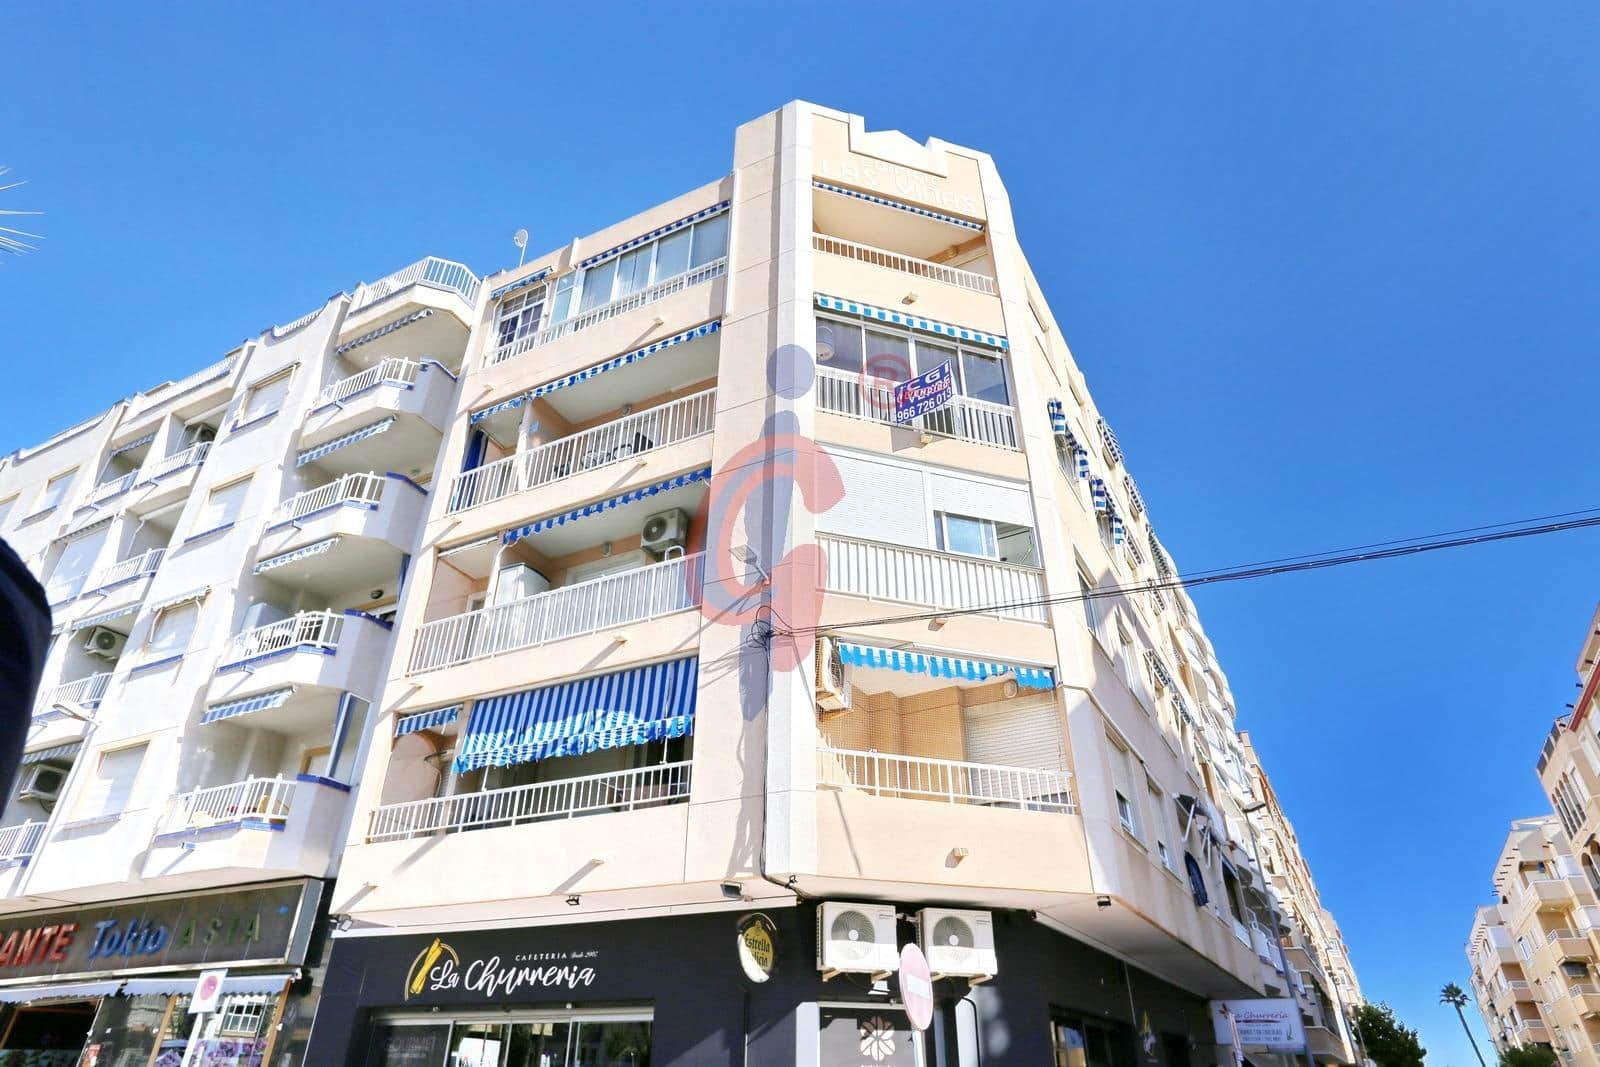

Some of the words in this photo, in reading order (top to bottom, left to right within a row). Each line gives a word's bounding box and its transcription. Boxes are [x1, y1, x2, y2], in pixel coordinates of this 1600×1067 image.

[897, 406, 916, 422] 966
[917, 398, 935, 414] 726
[0, 924, 80, 966] ANTE
[88, 917, 169, 960] Tokio
[515, 952, 567, 962] CAFETERIA
[430, 959, 460, 990] La
[465, 956, 597, 997] Churreria
